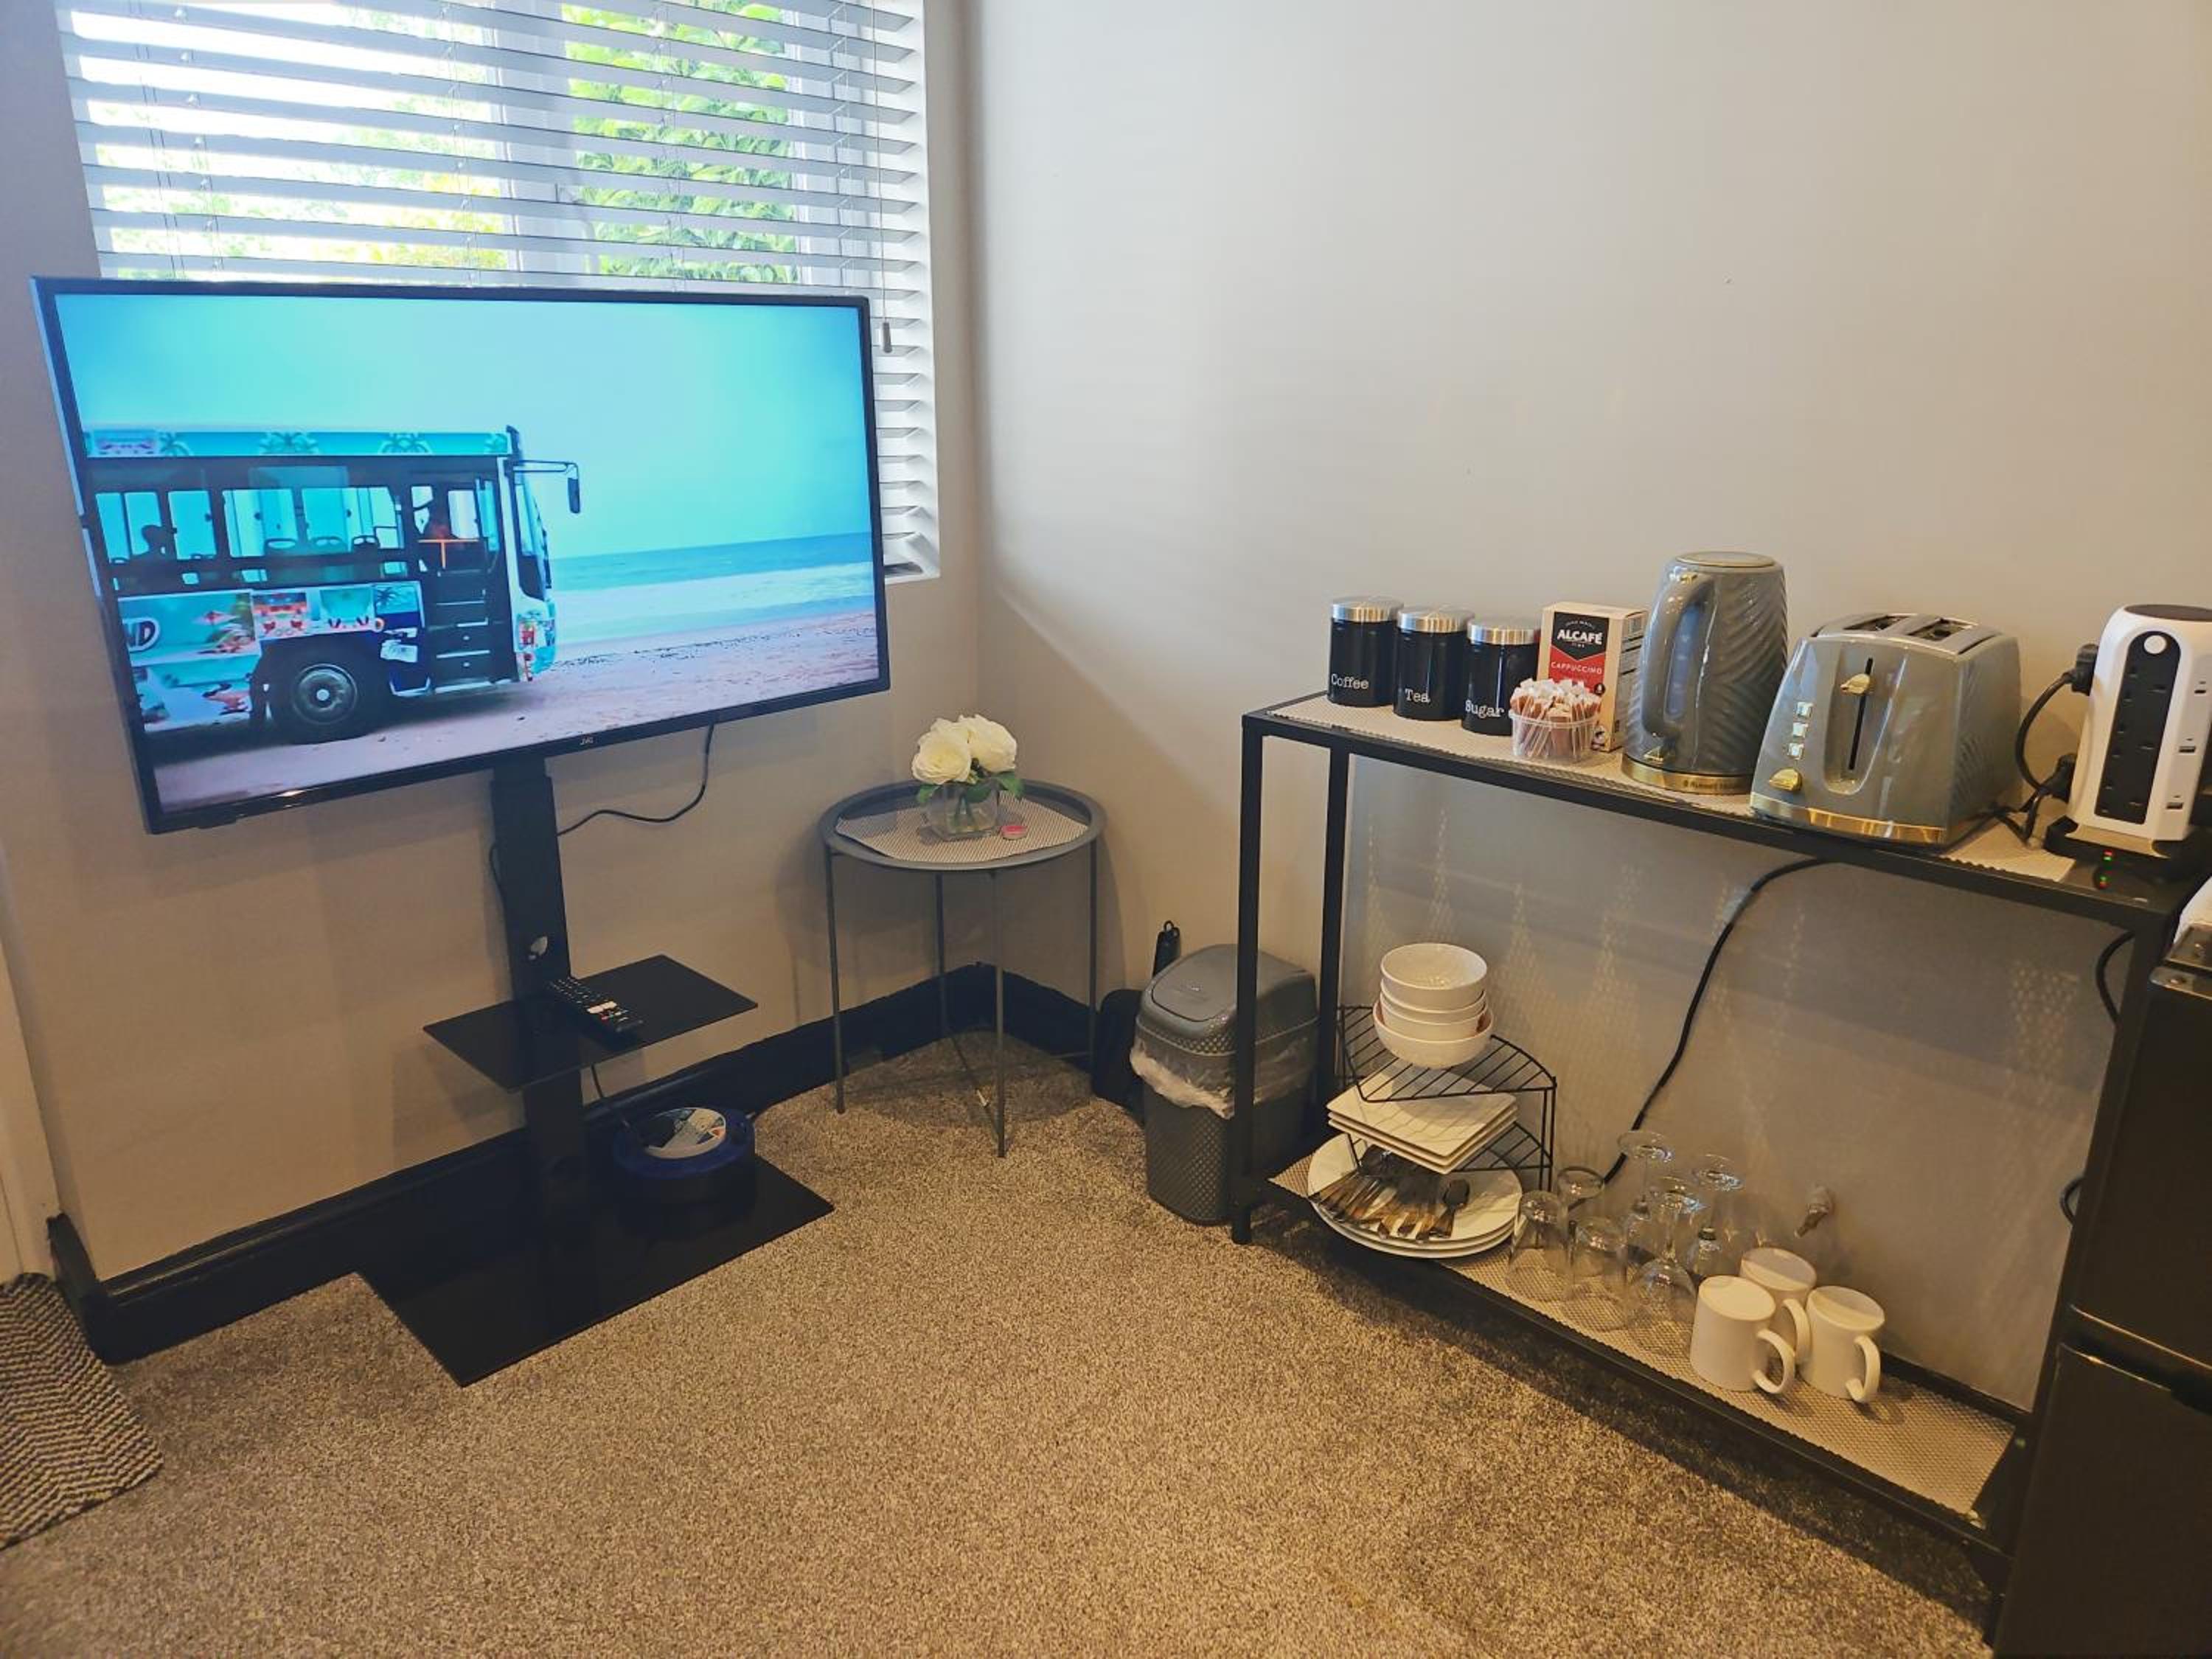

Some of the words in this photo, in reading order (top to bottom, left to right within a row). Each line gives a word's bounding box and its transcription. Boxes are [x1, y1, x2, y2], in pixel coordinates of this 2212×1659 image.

[1557, 628, 1604, 646] ALCAFÉ
[1550, 661, 1603, 675] CAPPUCCINO
[1330, 672, 1369, 690] Coffee
[1405, 687, 1431, 703] Tea
[1464, 699, 1505, 719] Sugar
